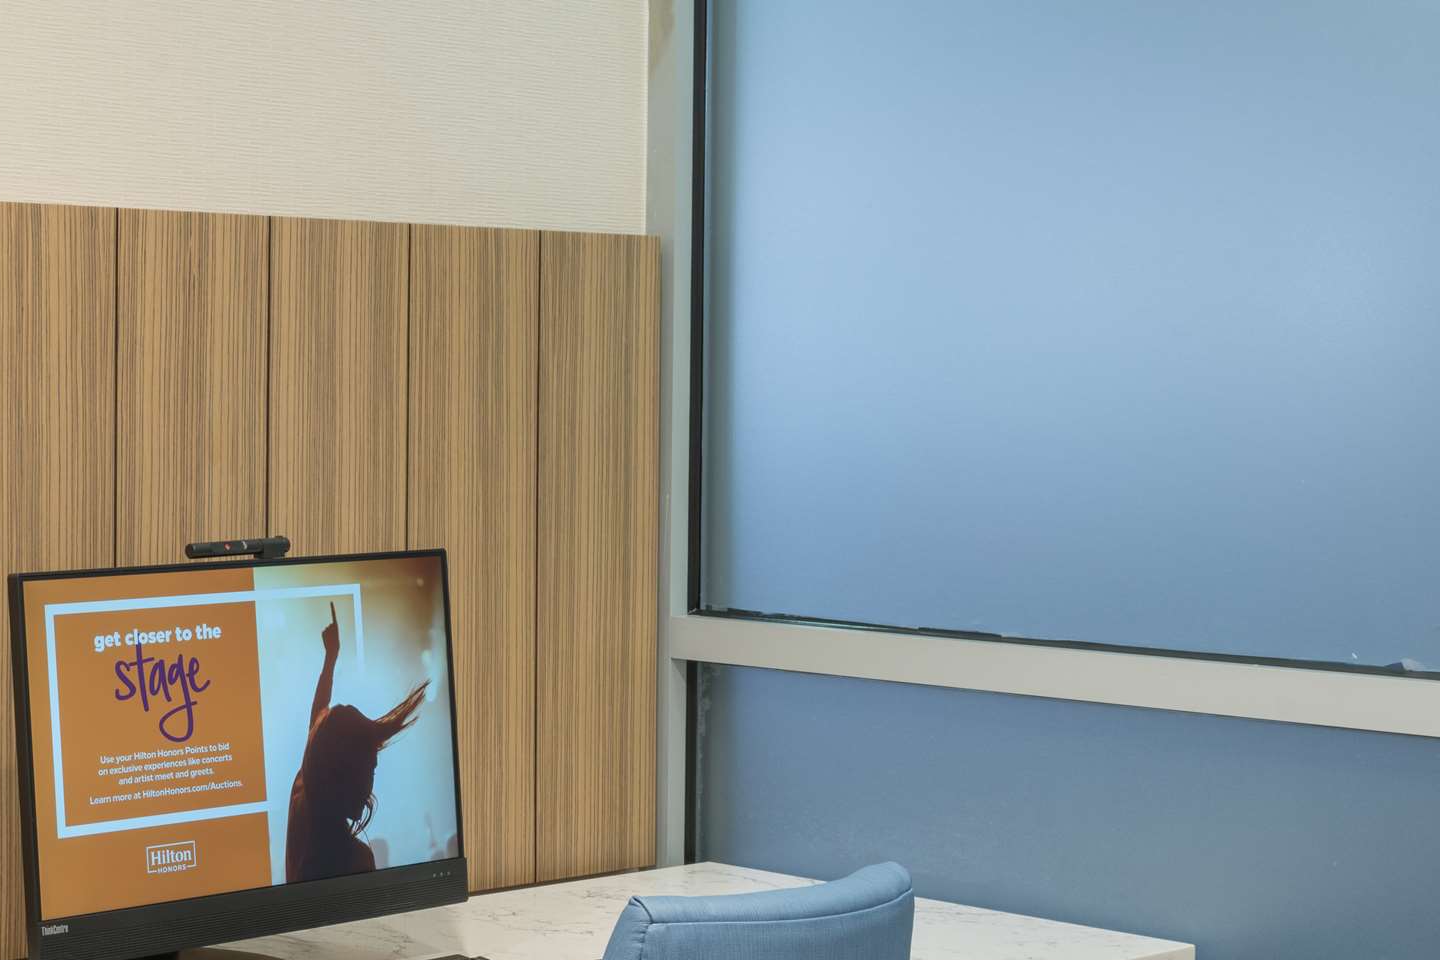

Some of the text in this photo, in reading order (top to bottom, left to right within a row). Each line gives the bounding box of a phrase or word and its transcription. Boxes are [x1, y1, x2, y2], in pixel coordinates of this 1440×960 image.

[93, 623, 222, 653] get closer to the
[114, 634, 211, 743] stage
[100, 742, 230, 764] Use your Hilton Honors Points to bid
[98, 754, 233, 776] on exclusive experiences like concerts
[119, 775, 133, 785] and
[134, 773, 154, 783] artist
[154, 771, 174, 781] meet
[175, 768, 189, 778] and
[89, 795, 111, 805] Learn
[112, 793, 133, 803] more
[133, 791, 142, 800] at
[151, 848, 192, 866] Hilton
[157, 863, 187, 874] HONORS
